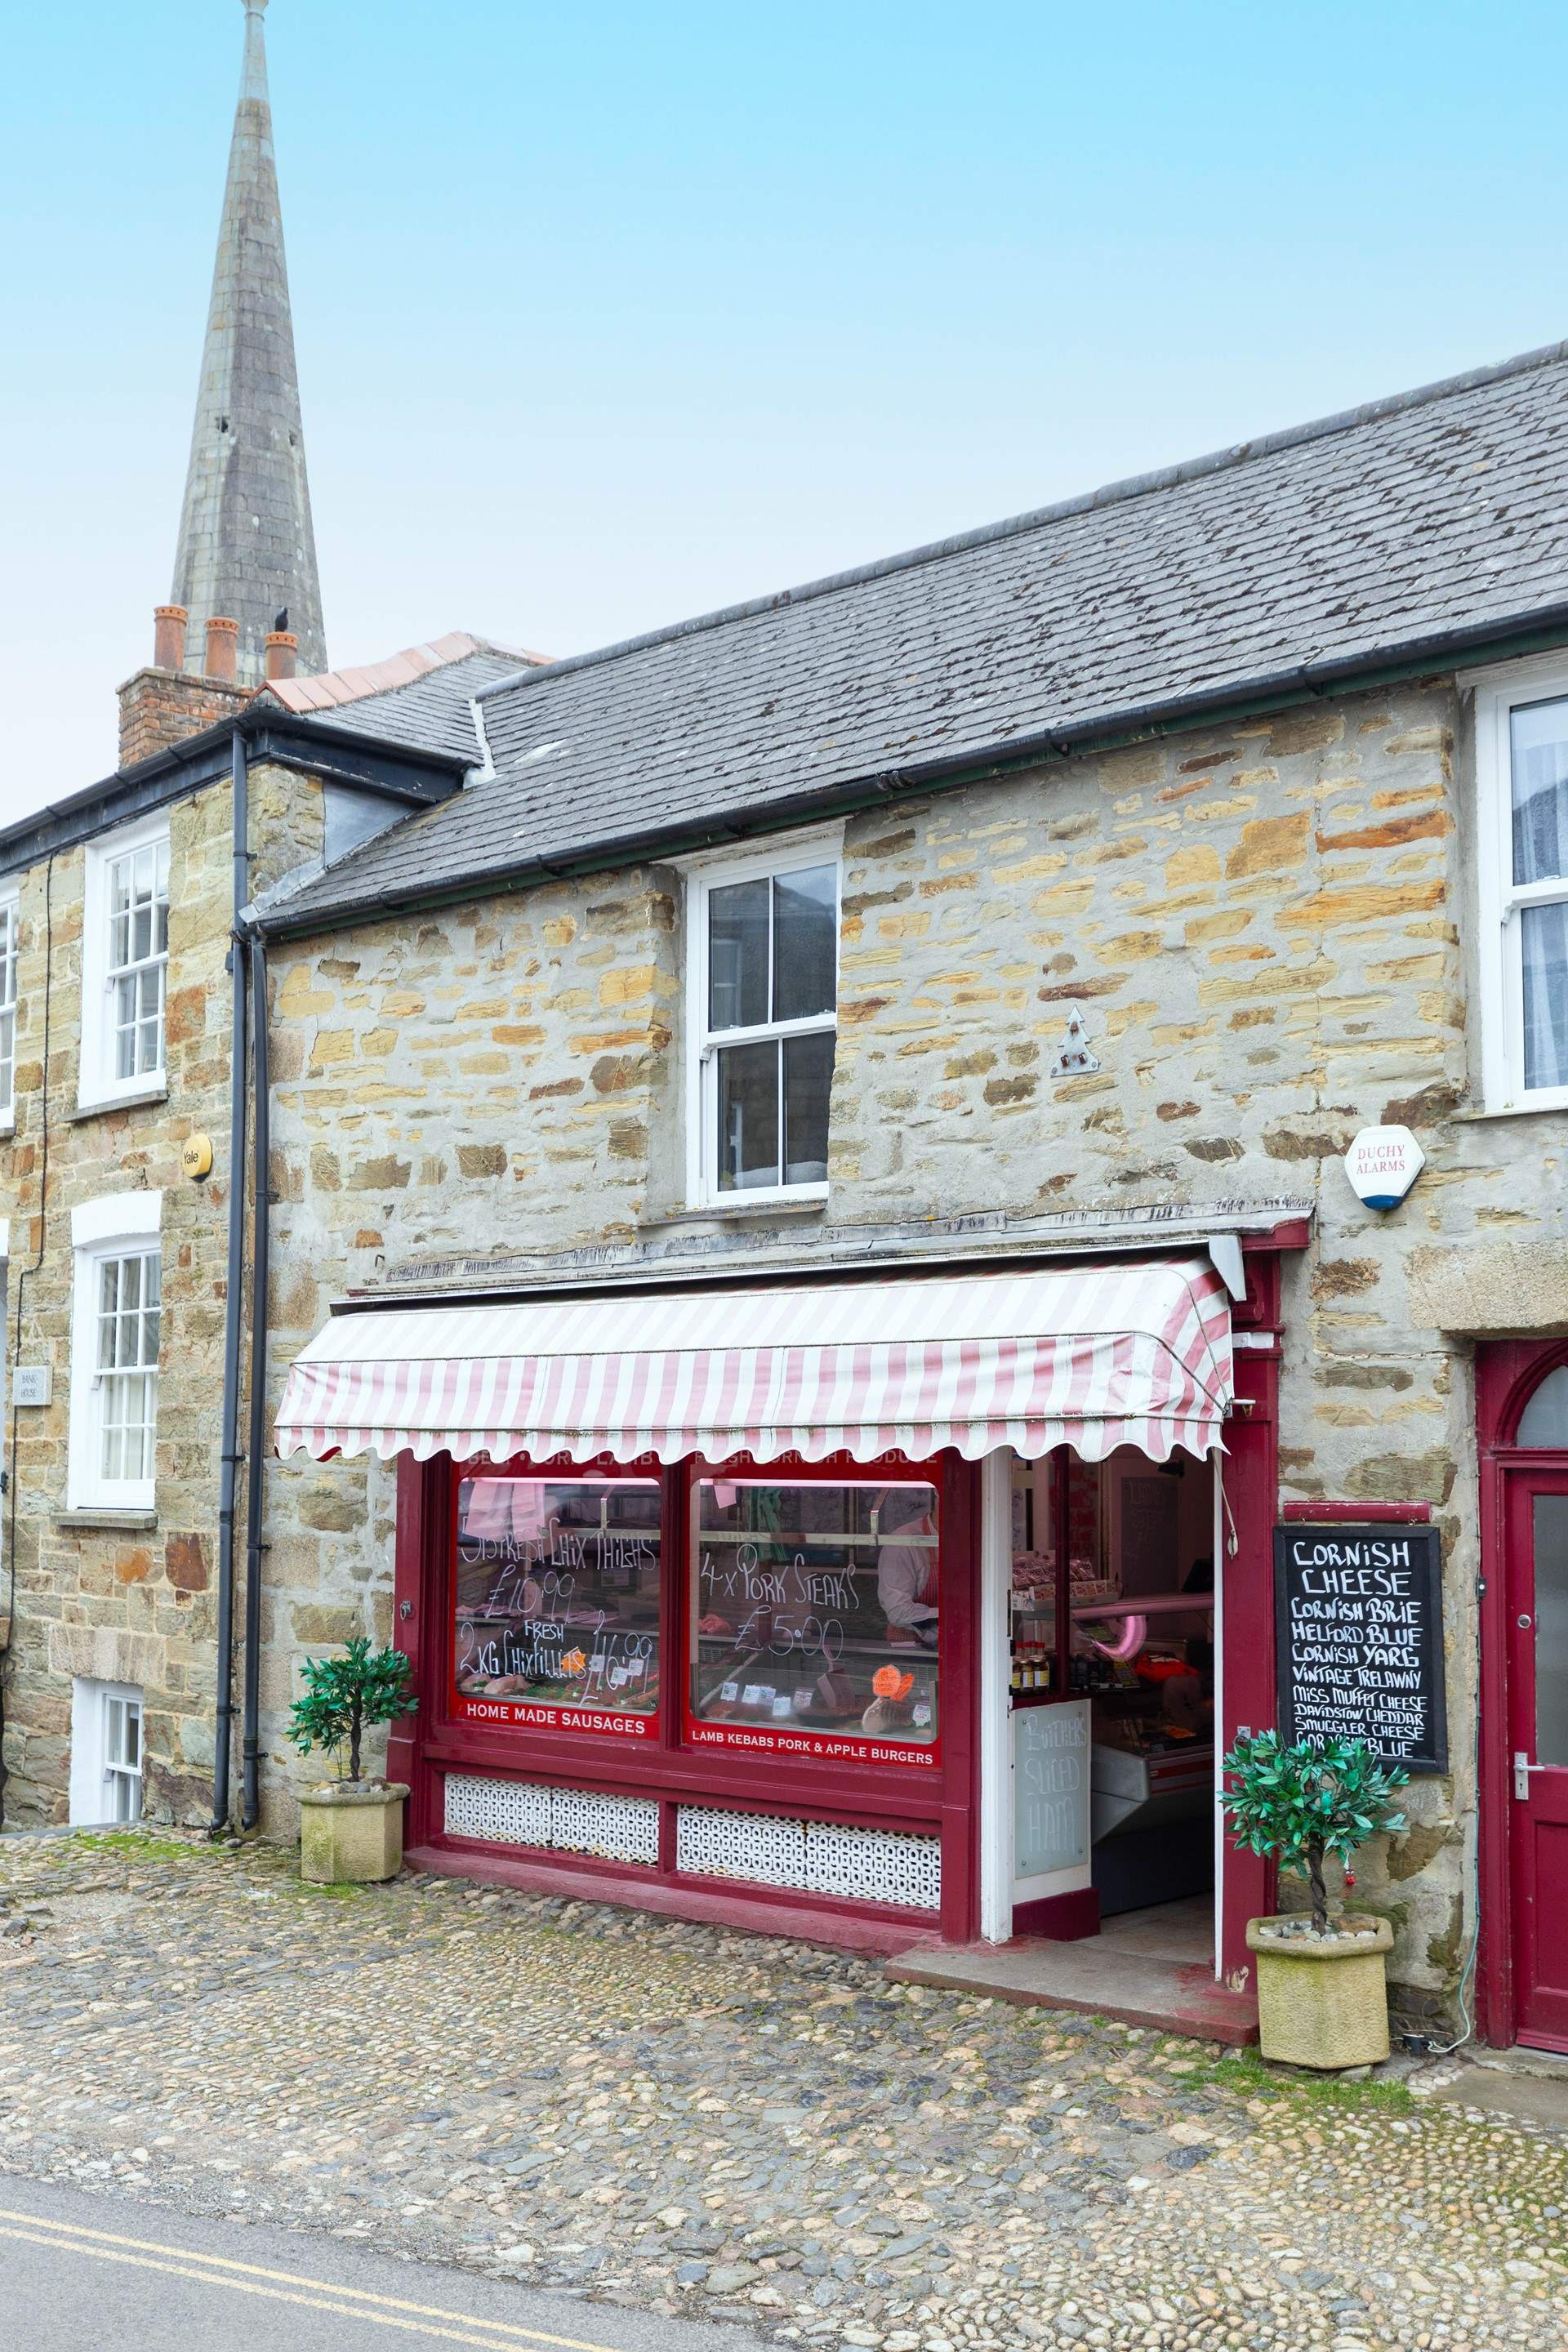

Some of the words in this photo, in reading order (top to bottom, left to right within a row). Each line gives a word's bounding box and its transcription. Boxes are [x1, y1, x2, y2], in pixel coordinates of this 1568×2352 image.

[183, 1150, 199, 1165] Yale
[1357, 1144, 1405, 1160] DUCHY
[1356, 1160, 1405, 1174] ALARMS
[20, 1388, 38, 1397] HOUSE
[1293, 1541, 1410, 1567] CORNISH
[737, 1544, 789, 1604] PORK
[794, 1552, 860, 1609] STEAKS
[1301, 1569, 1412, 1596] CHEESE
[485, 1564, 576, 1624] £10.99
[1290, 1597, 1363, 1621] CORNISH
[524, 1619, 564, 1642] FRESH
[734, 1605, 844, 1661] £5.00
[1291, 1620, 1364, 1644] HELFORD
[1365, 1624, 1424, 1646] BLUE
[1363, 1645, 1420, 1668] YARG
[1353, 1665, 1422, 1690] TRELAWNY
[1332, 1687, 1379, 1707] MUFFET
[1379, 1695, 1428, 1713] CHEESE
[466, 1704, 509, 1720] HOME
[514, 1708, 557, 1724] MADE
[561, 1713, 645, 1734] SAUSAGES
[1294, 1717, 1372, 1737] SMUGGLER
[1372, 1723, 1426, 1741] CHEESE
[1365, 1708, 1424, 1726] CHEDDAR
[1025, 1714, 1087, 1751] BUTCHERS
[692, 1730, 724, 1743] LAMB
[728, 1733, 774, 1748] KEBABS
[777, 1738, 810, 1752] PORK
[813, 1740, 822, 1753] &
[826, 1742, 867, 1757] APPLE
[871, 1747, 933, 1765] BURGERS
[1364, 1737, 1415, 1758] BLUE
[1027, 1796, 1076, 1856] HAM
